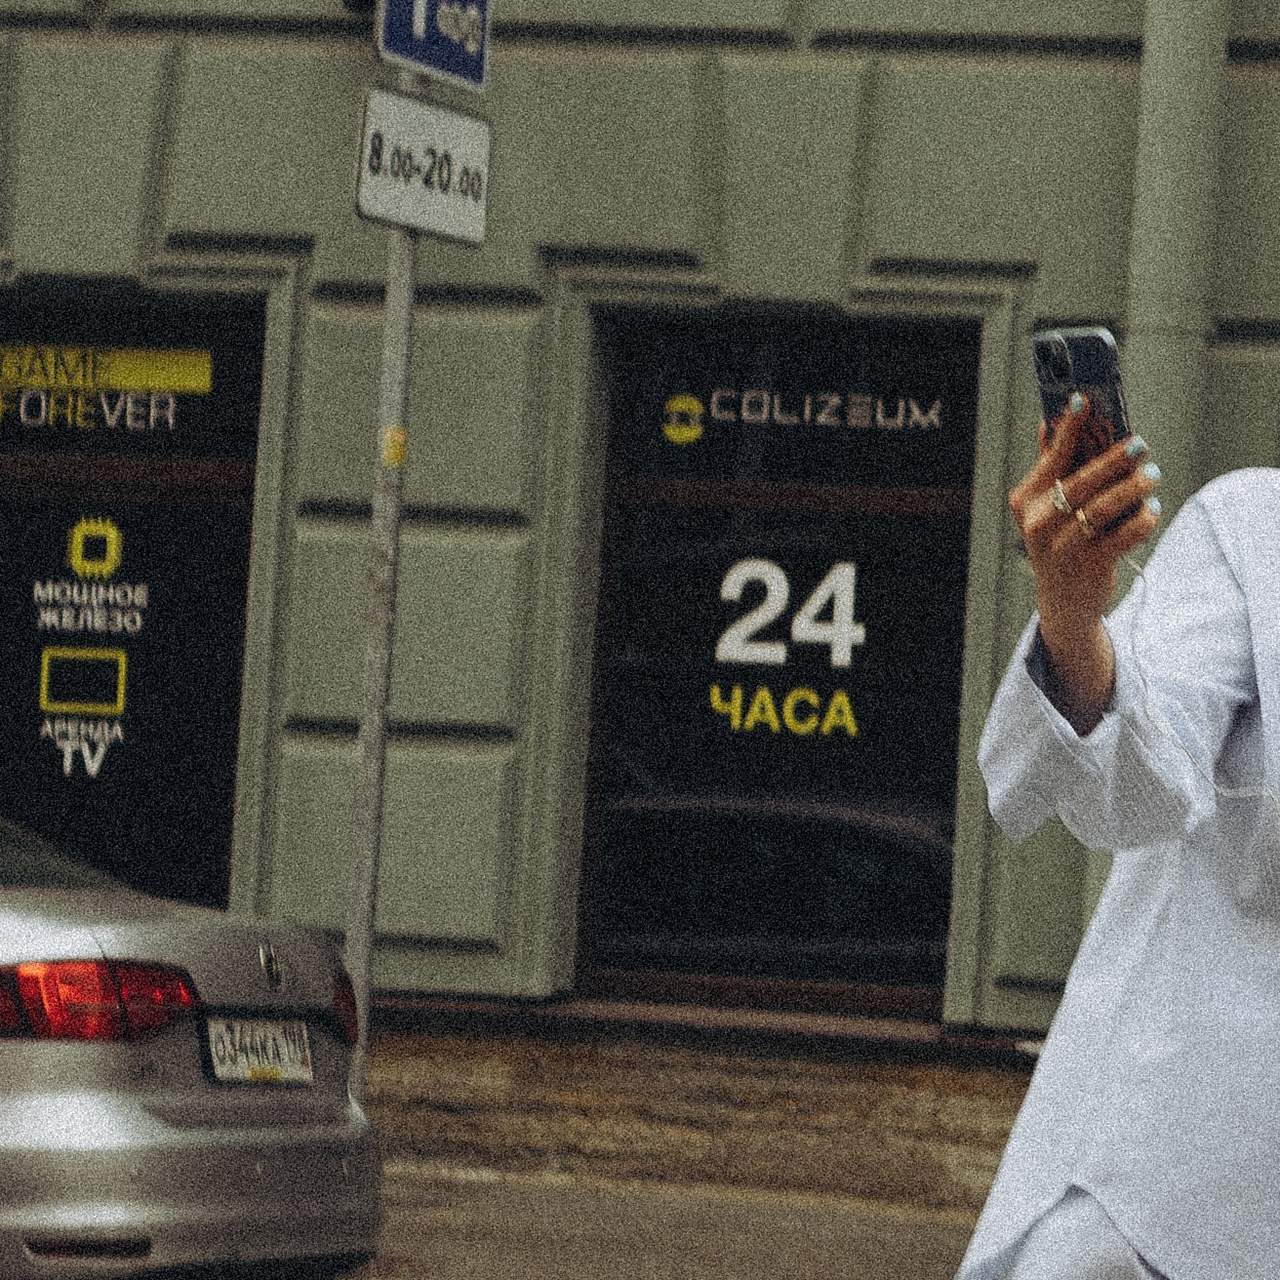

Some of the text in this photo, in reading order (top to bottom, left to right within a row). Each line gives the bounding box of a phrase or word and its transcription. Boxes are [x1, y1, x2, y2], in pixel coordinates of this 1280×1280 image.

[710, 387, 943, 430] COLIZEUM
[33, 580, 150, 610] МОЩНОЕ
[714, 557, 866, 669] 24
[709, 684, 859, 738] ЧАСА
[57, 740, 110, 777] TV
